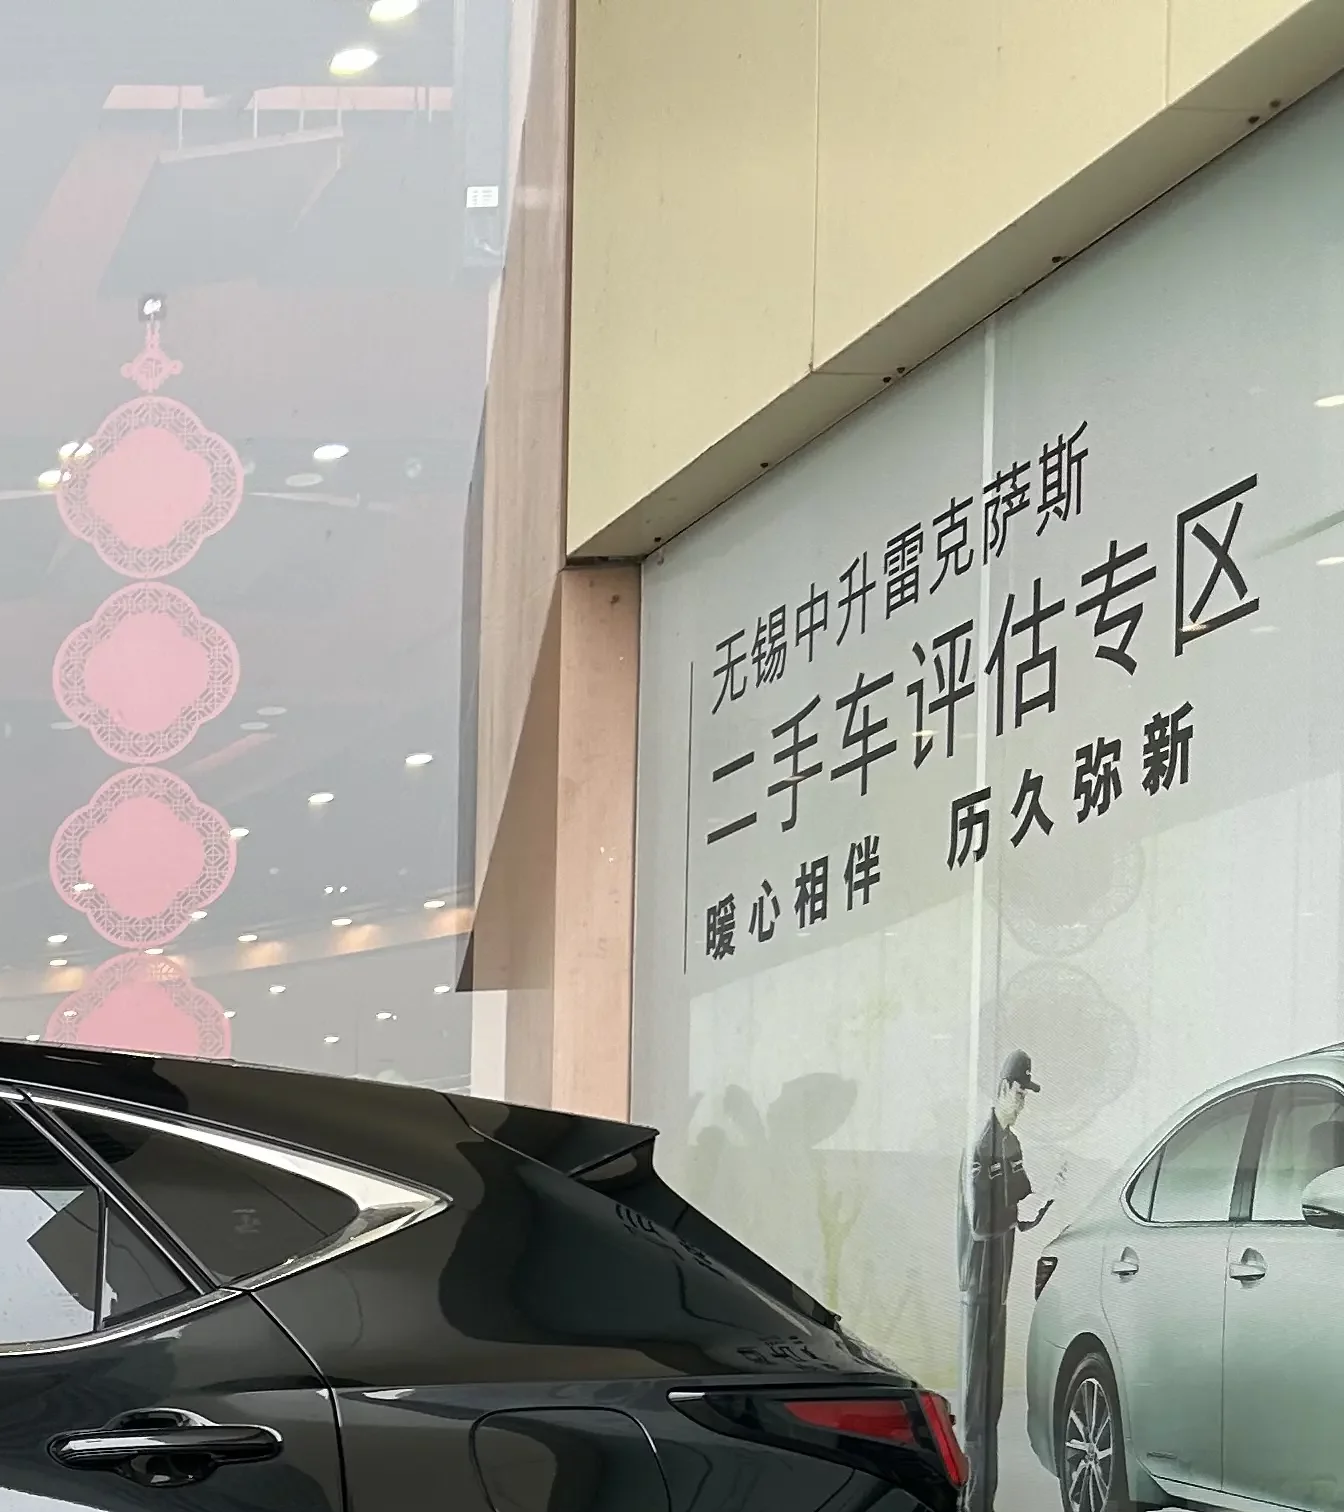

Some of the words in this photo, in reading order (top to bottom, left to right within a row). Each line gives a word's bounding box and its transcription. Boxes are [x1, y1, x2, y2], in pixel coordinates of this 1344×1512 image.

[707, 473, 1261, 845] 二手车评估专区
[712, 421, 1089, 715] 无锡中升雷克萨斯
[706, 835, 881, 960] 暖心相伴
[947, 700, 1195, 871] 历久弥新
